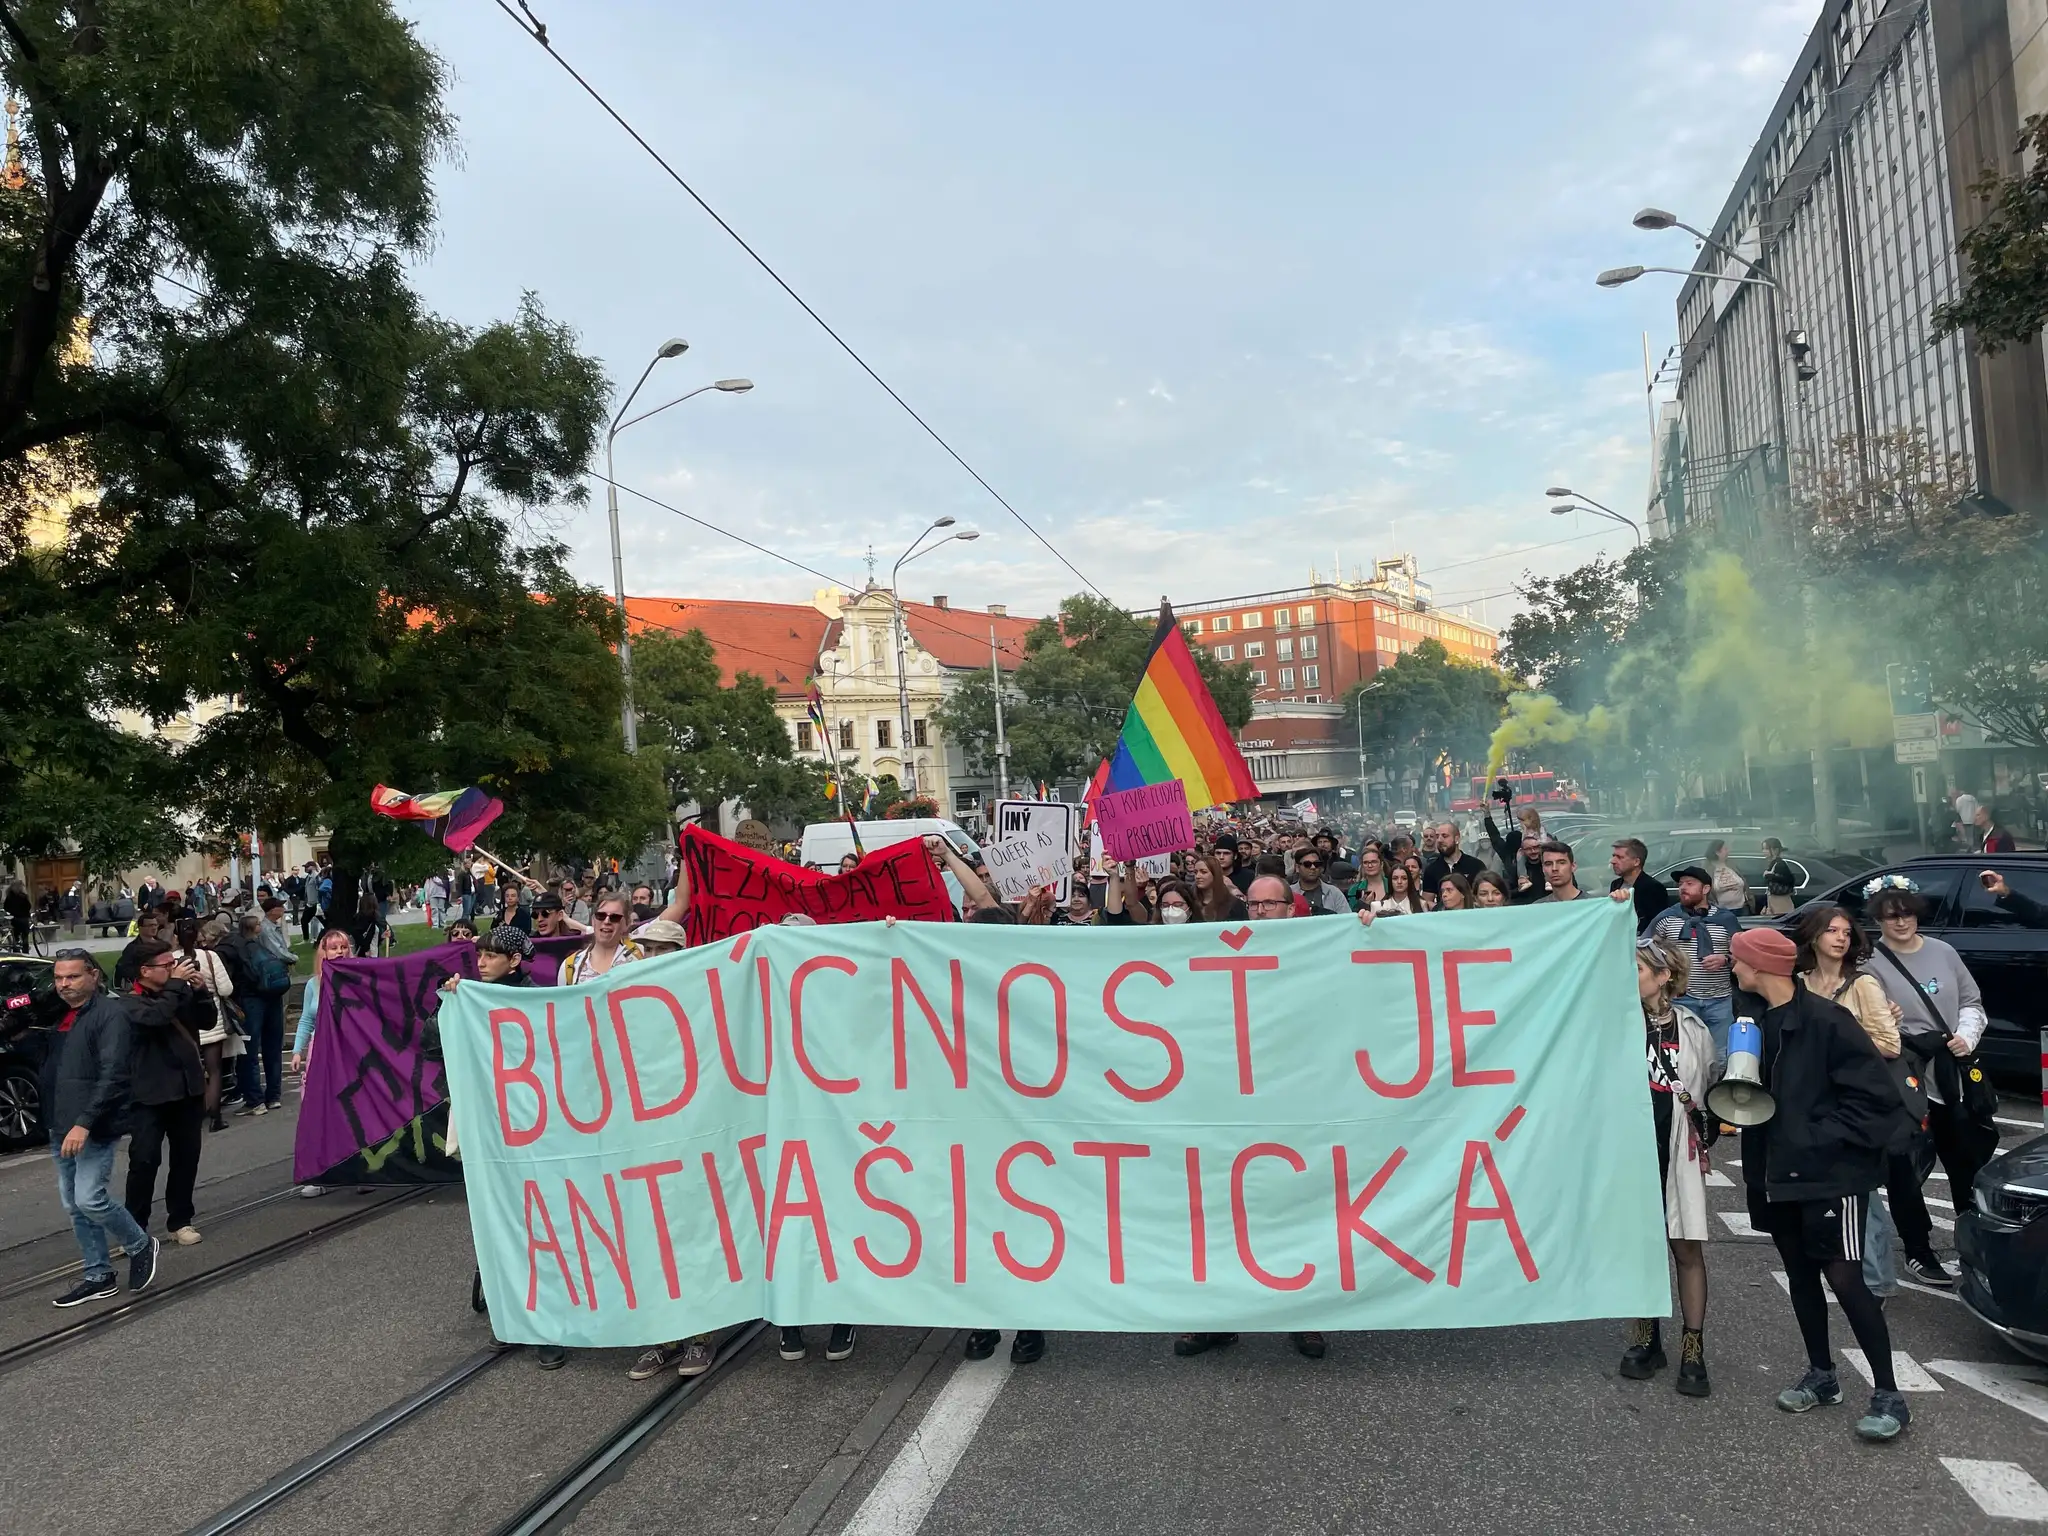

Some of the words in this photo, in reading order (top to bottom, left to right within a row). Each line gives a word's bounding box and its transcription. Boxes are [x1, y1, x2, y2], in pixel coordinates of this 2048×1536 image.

[1004, 806, 1031, 832] INÝ
[1100, 797, 1116, 822] AJ
[1036, 831, 1053, 848] AS
[1126, 815, 1187, 857] PRACUJÚCI
[1021, 858, 1031, 870] IN
[995, 875, 1025, 898] FUCK
[488, 925, 1279, 1147] BUDÚCNOSŤ
[1351, 947, 1516, 1099] JE
